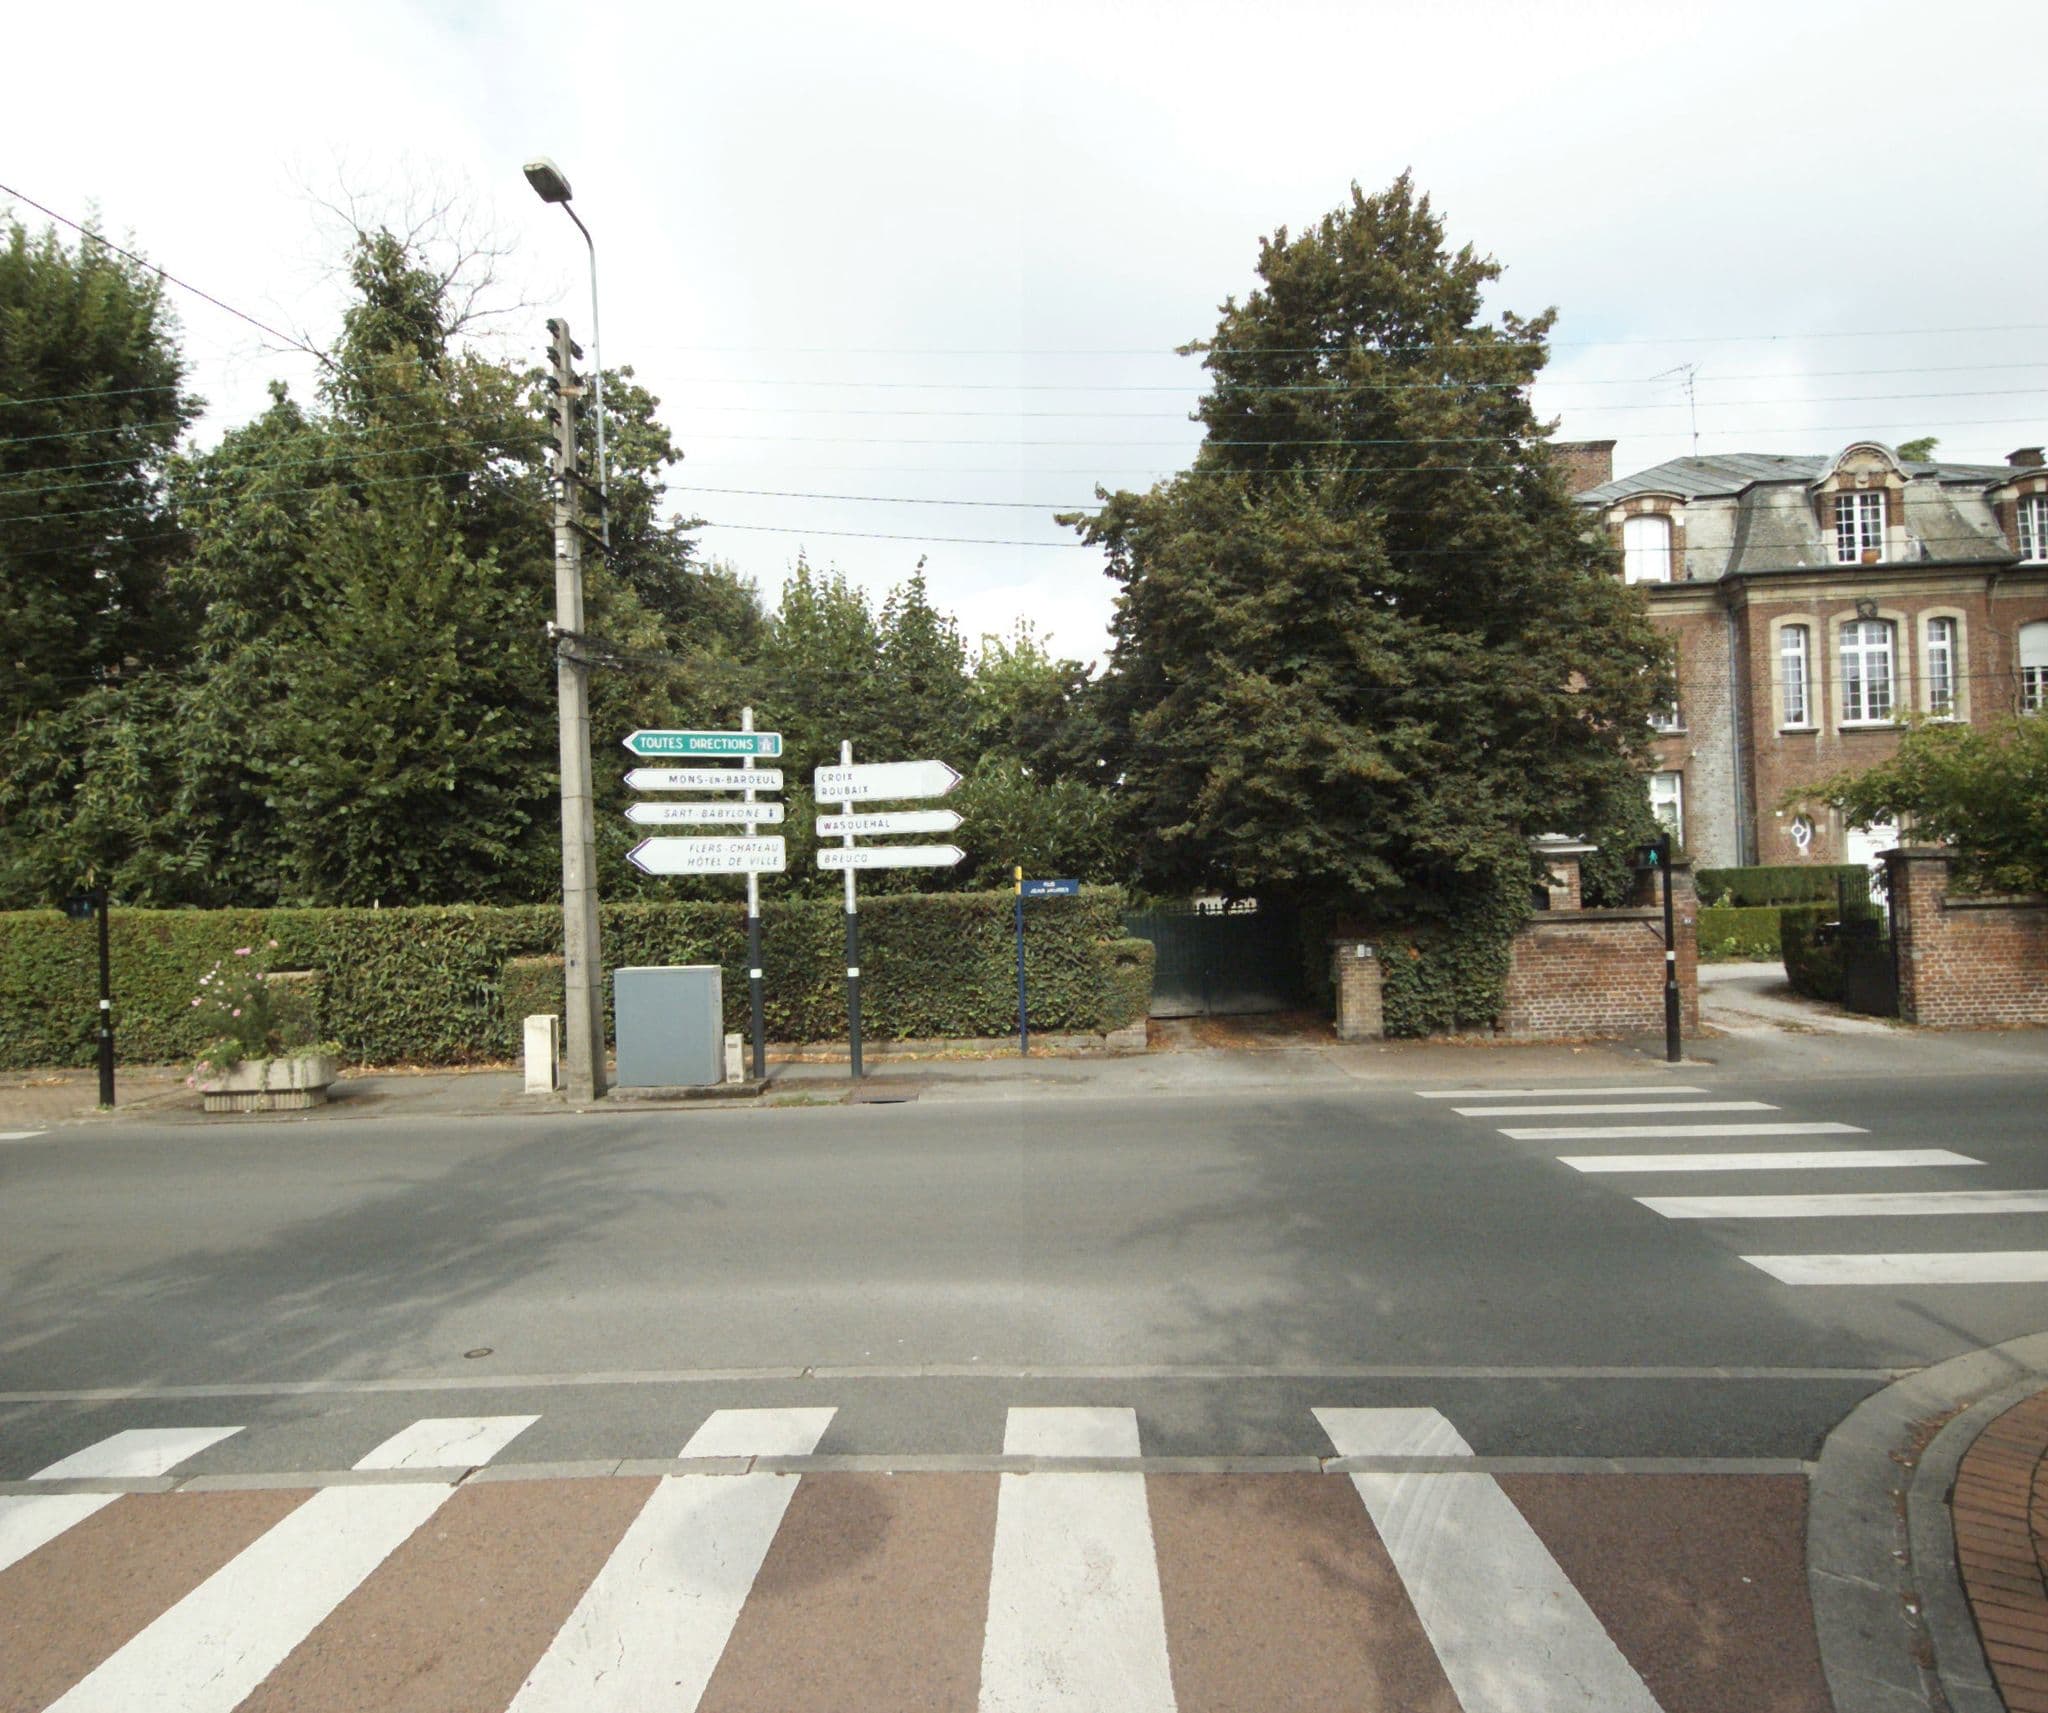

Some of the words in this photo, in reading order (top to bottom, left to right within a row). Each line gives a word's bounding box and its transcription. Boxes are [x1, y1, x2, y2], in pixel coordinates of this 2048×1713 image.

[640, 736, 683, 749] TOUTES
[690, 737, 754, 750] DIRECTIONS
[821, 773, 853, 783] CROIX
[822, 785, 869, 796] ROUBAIX
[823, 818, 891, 830] WASQUEHAL
[728, 857, 742, 867] DE
[749, 856, 779, 866] VILLE
[824, 854, 869, 864] BREUCQ
